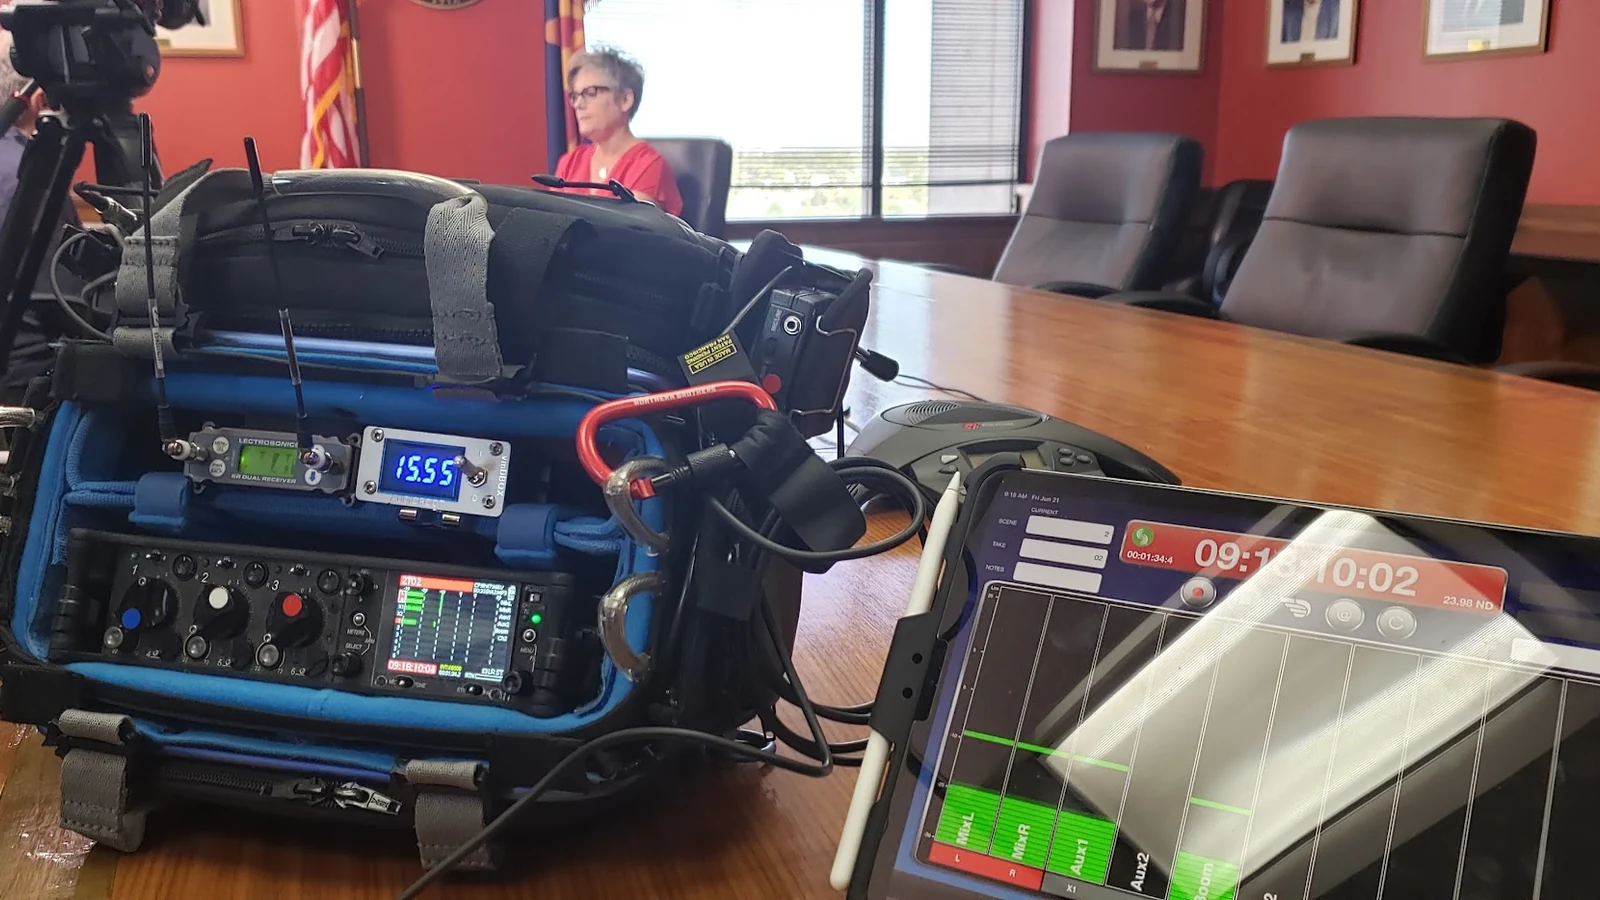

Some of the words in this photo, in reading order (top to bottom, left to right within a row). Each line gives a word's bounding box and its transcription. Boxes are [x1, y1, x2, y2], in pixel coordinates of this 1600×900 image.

[684, 341, 717, 360] FRANCISCO
[711, 338, 733, 353] PATENT
[714, 348, 731, 361] MADE
[694, 361, 708, 370] USA
[396, 455, 455, 486] 15.55
[261, 476, 297, 485] RECEIVER
[1030, 507, 1059, 515] CURRENT
[998, 518, 1018, 526] SCENE
[1127, 550, 1174, 564] 00:01:34:4
[132, 564, 138, 575] 1
[985, 564, 1005, 573] NOTES
[201, 572, 209, 583] 2
[271, 579, 280, 591] 3
[1443, 595, 1473, 608] 23.98
[1475, 599, 1494, 611] ND
[344, 642, 363, 650] SELECT
[955, 811, 976, 846] MixL
[1011, 823, 1031, 861] MixR
[1070, 838, 1089, 876] Aux1
[1010, 868, 1016, 877] R
[1130, 852, 1150, 892] Aux2
[1066, 884, 1077, 893] X1
